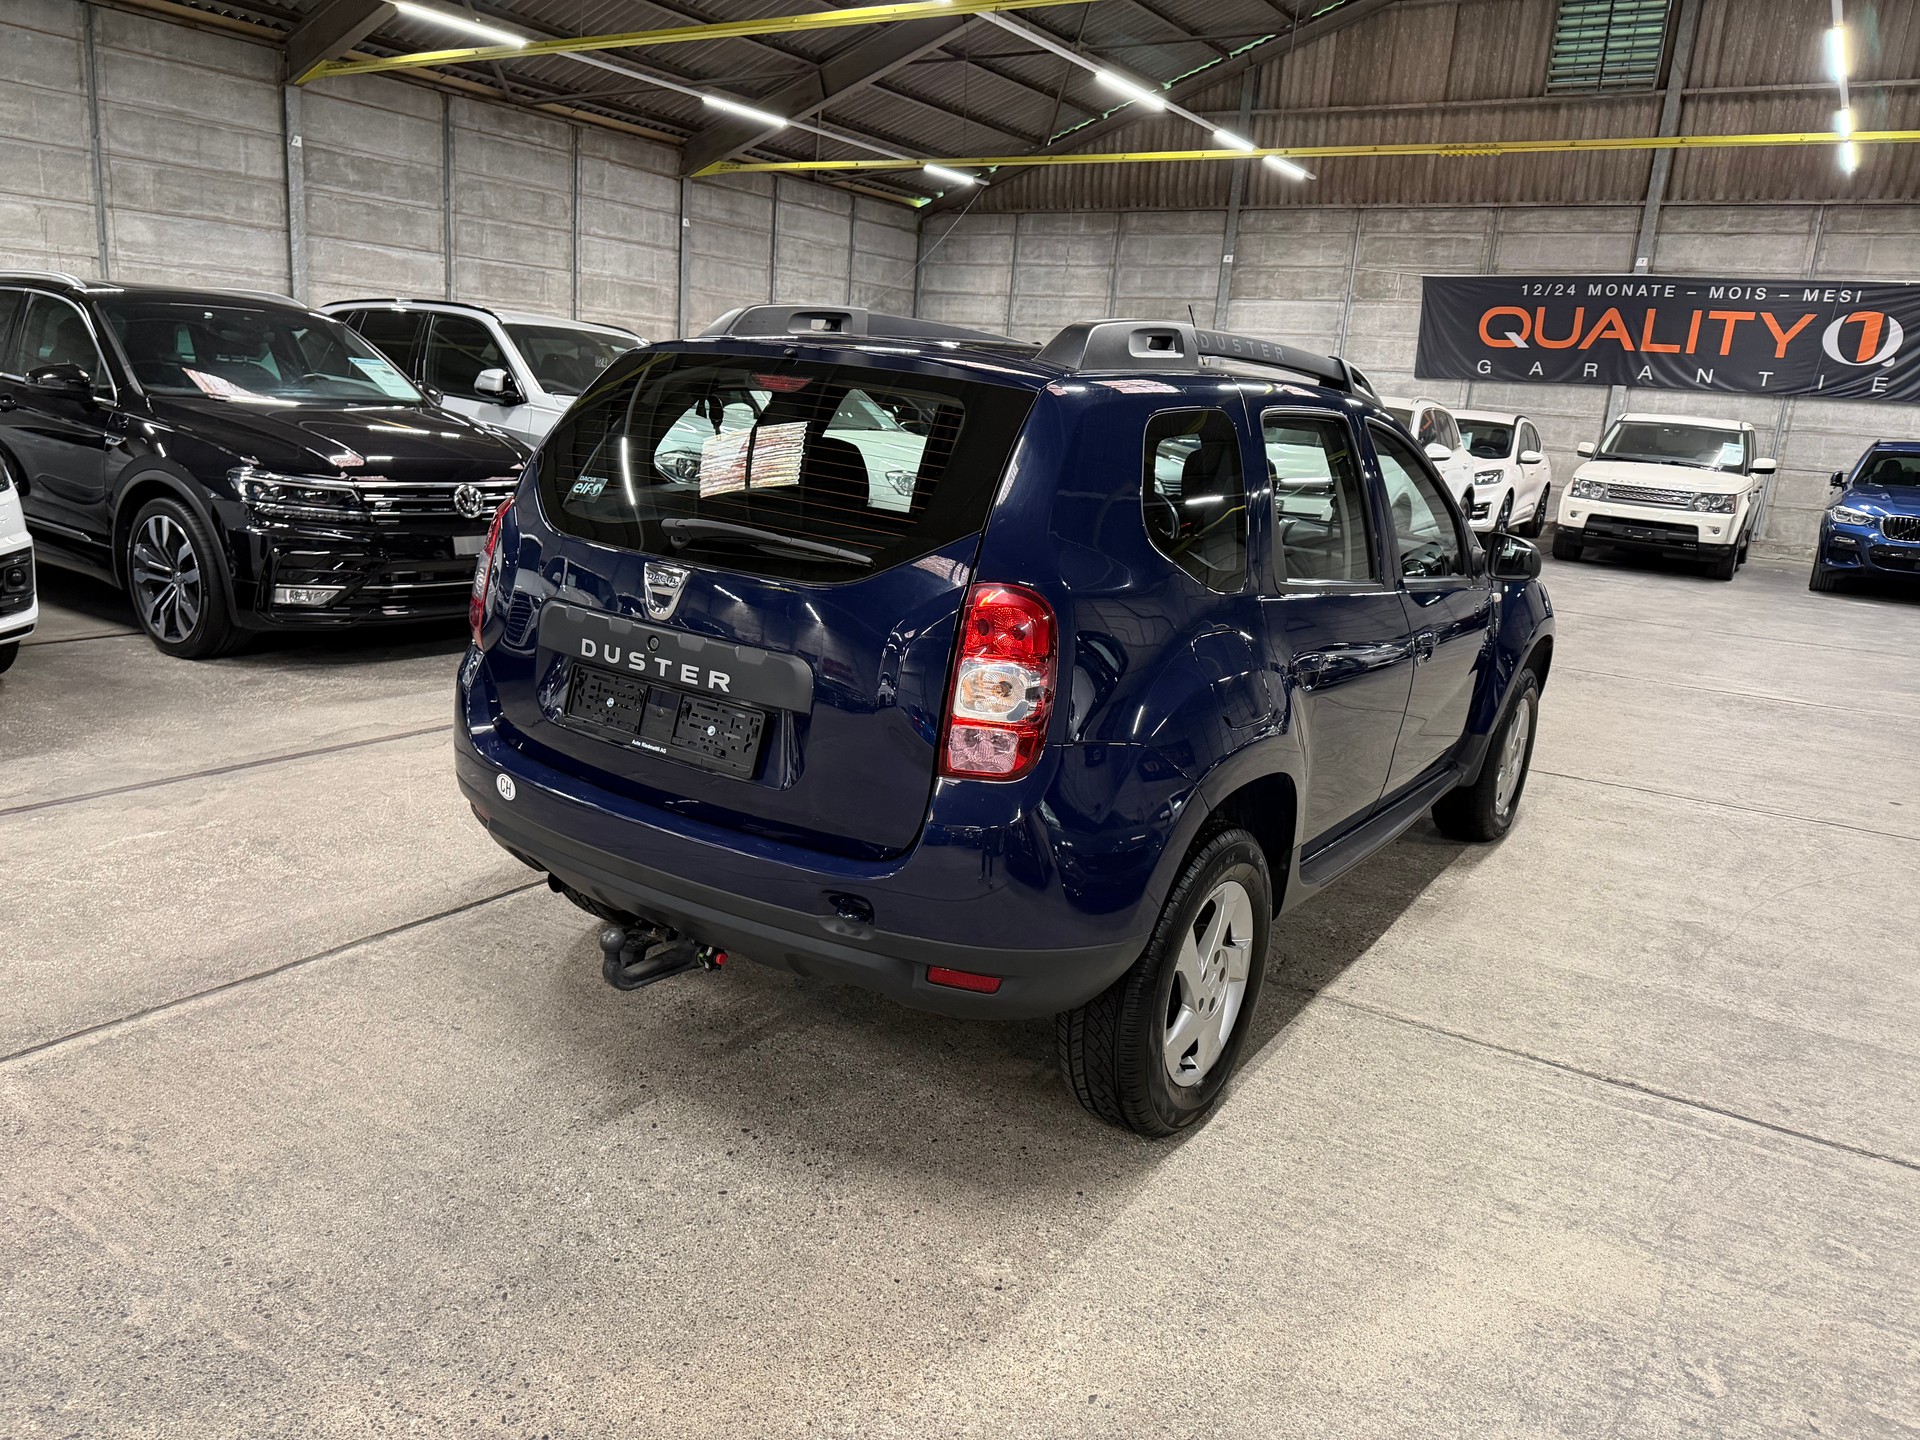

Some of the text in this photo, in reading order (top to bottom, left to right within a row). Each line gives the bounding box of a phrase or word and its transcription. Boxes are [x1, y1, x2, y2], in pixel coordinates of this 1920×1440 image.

[1521, 283, 1577, 297] 12/24
[1588, 283, 1677, 298] MONATE
[1709, 286, 1768, 301] MOIS
[1802, 288, 1863, 303] MESI
[1478, 306, 1818, 359] QUALITY
[1199, 333, 1285, 361] DUSTER
[1476, 359, 1890, 393] GARANTIE
[572, 482, 595, 495] elf
[578, 475, 597, 483] DACIA
[580, 637, 731, 693] DUSTER
[500, 777, 513, 797] CH
